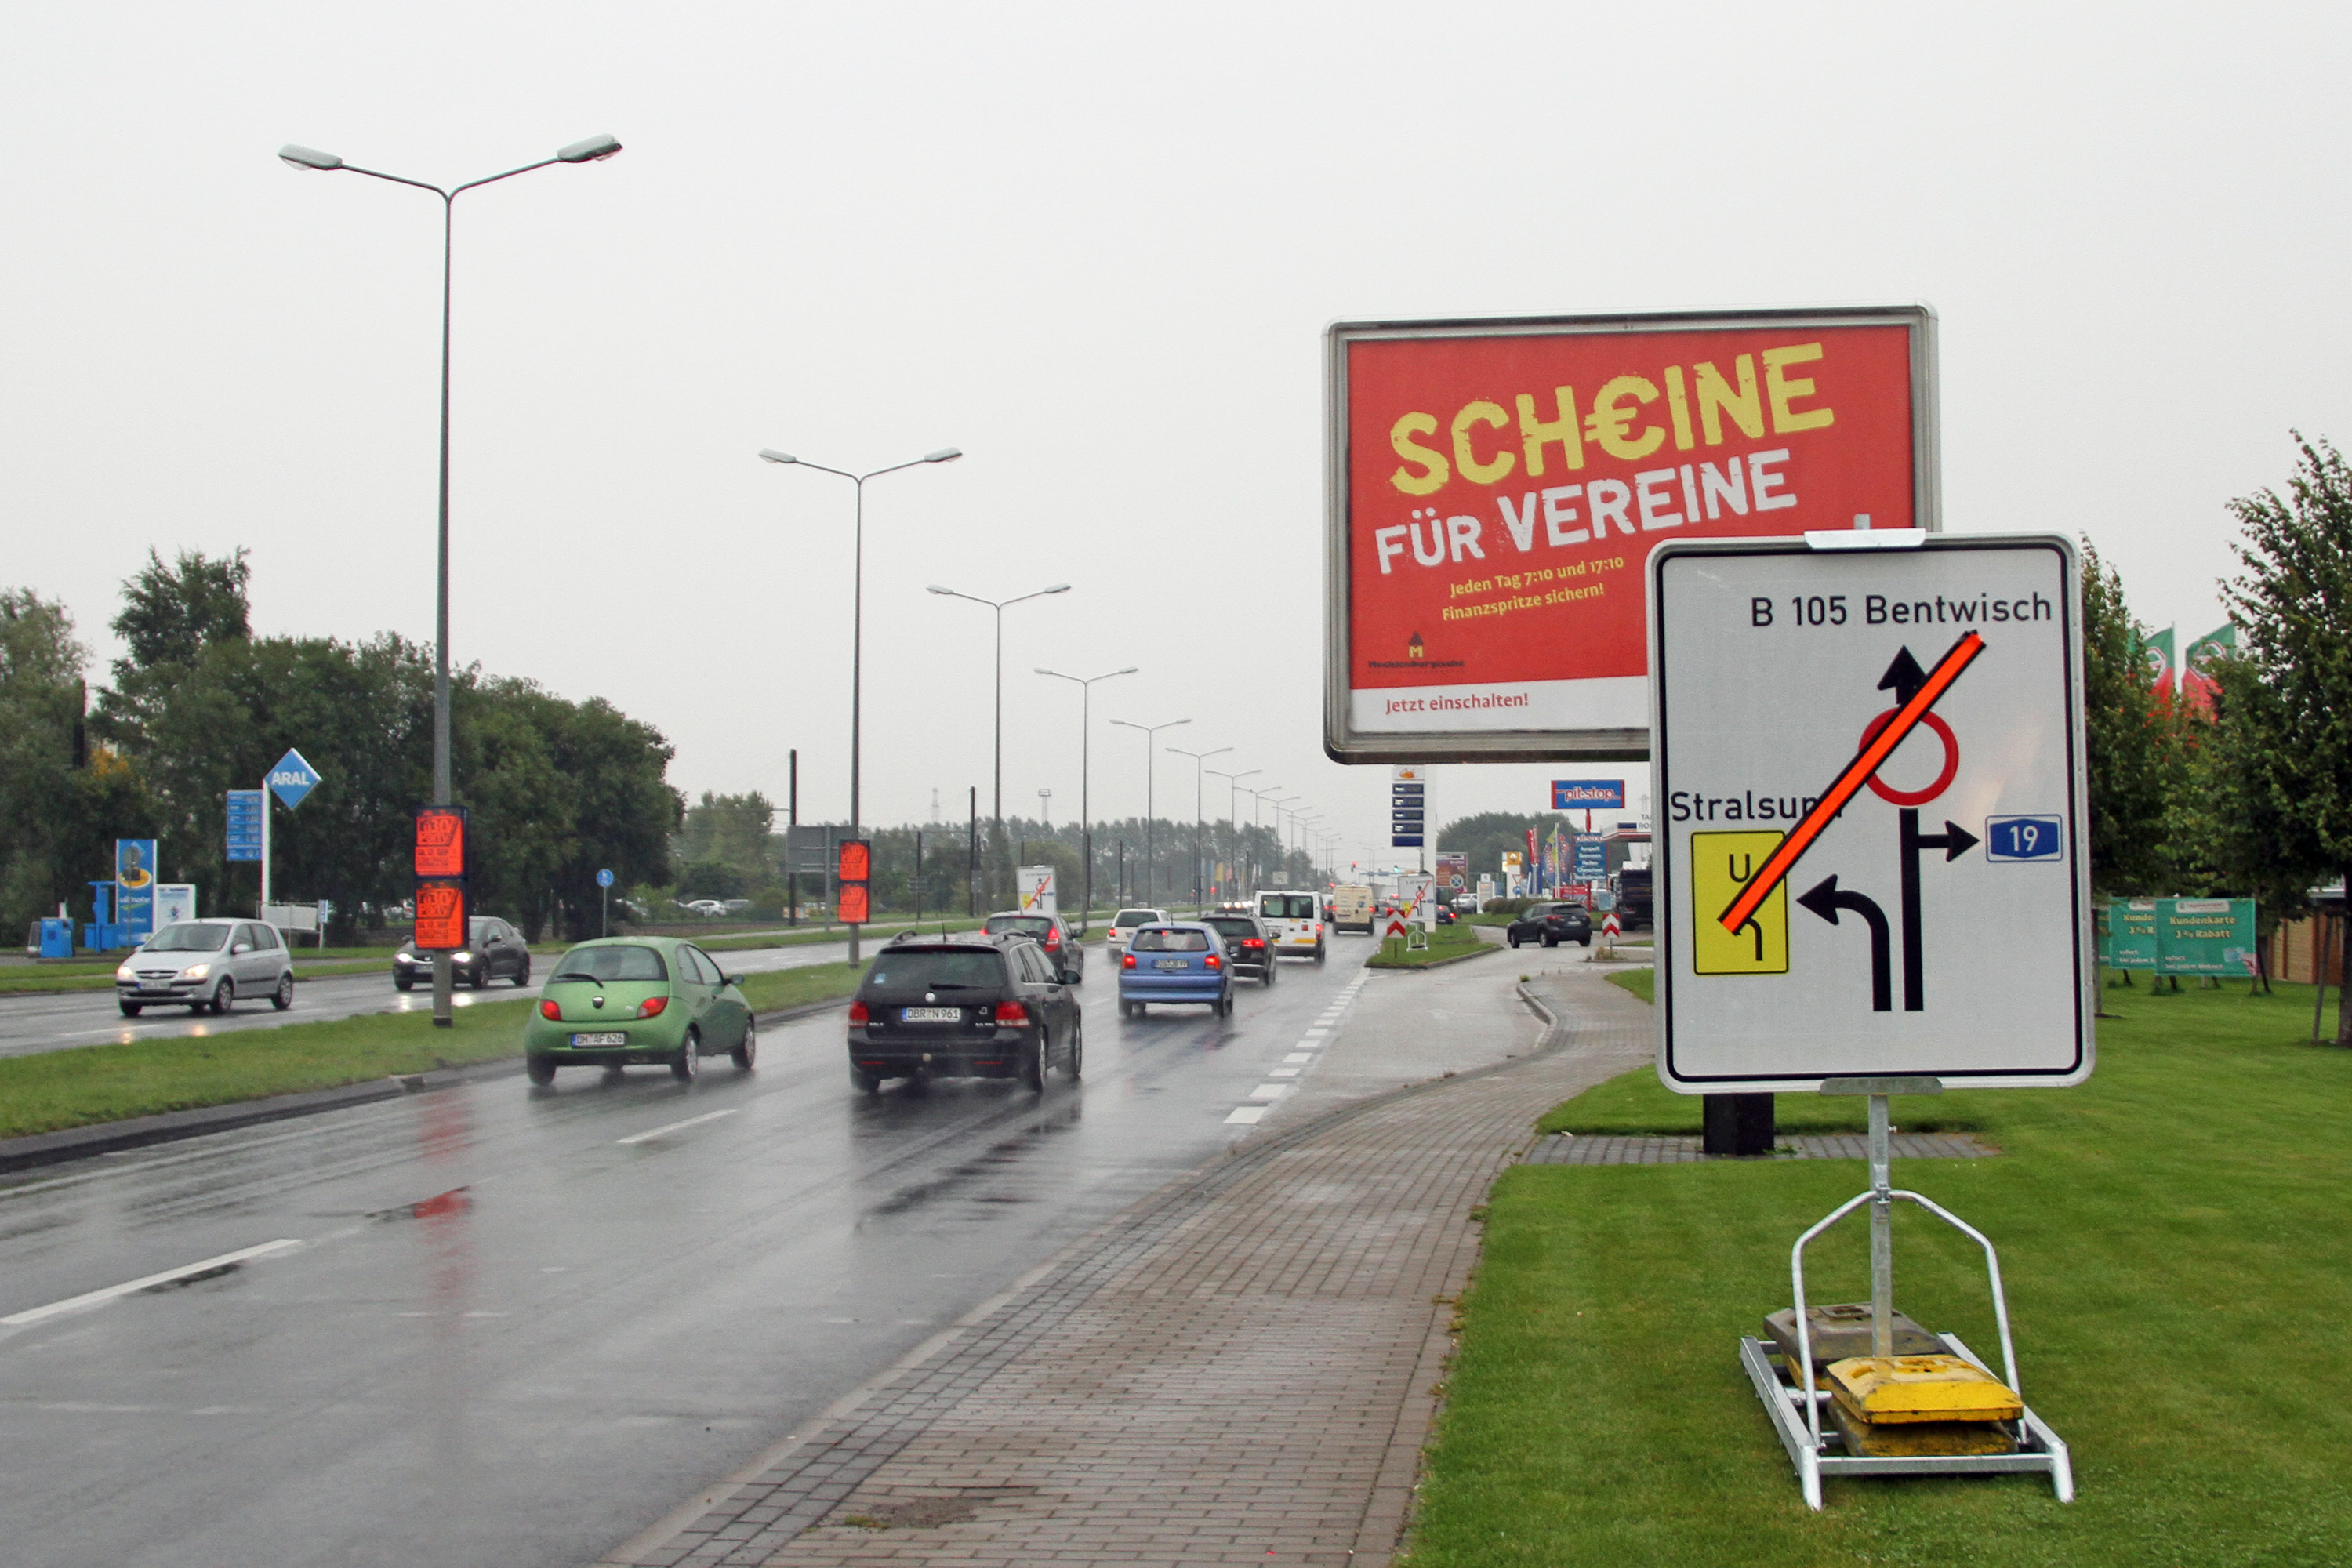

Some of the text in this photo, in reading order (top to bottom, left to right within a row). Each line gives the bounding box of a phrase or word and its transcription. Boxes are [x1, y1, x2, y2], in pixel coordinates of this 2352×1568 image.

[1389, 342, 1835, 495] SCH€INE
[1374, 448, 1797, 575] FÜR VEREINE
[1450, 557, 1624, 598] Jeden Tag 7:10 und 17:10
[1442, 582, 1605, 621] Finanzspritze sichern!
[1751, 592, 2051, 626] B 105 Bentwisch
[1386, 692, 1529, 715] Jetzt einschalten!
[271, 771, 310, 785] ARAL
[2009, 825, 2038, 851] 19
[1729, 853, 1750, 883] U
[2169, 916, 2236, 924] Kundenkarte
[2176, 930, 2182, 938] 3
[2196, 929, 2231, 938] Rabatt
[907, 1008, 959, 1018] DBR N 961
[607, 1034, 623, 1044] 626
